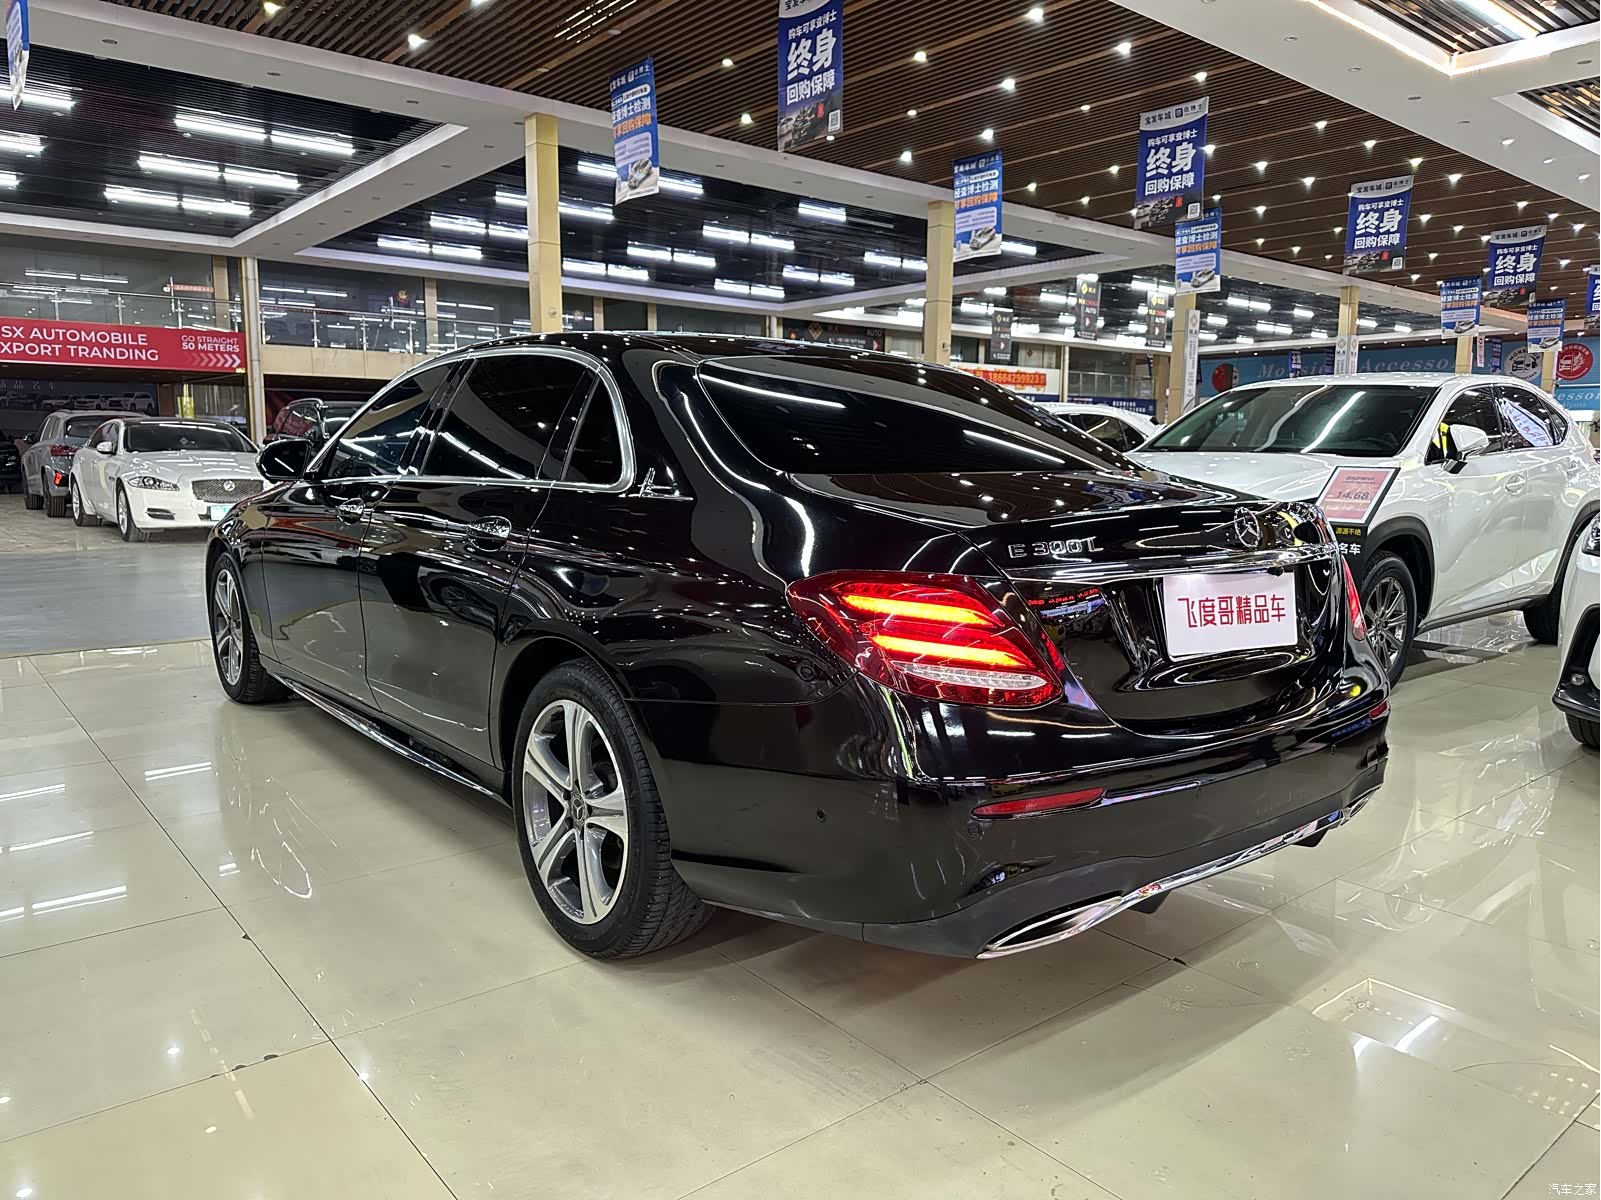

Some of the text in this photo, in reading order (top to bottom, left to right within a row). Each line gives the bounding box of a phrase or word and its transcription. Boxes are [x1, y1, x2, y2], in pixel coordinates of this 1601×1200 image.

[788, 9, 838, 41] 购车可享查博士
[787, 28, 837, 81] 终身
[786, 69, 836, 106] 回购保障
[1147, 128, 1198, 147] 购车可享查博士
[1145, 141, 1197, 178] 终身
[1144, 172, 1195, 196] 回购保障
[1358, 198, 1405, 212] 购车可享查博士
[1355, 208, 1403, 235] 终身
[1354, 233, 1401, 250] 回购保障
[1495, 252, 1537, 275] 终身
[1493, 272, 1536, 287] 回购保障
[30, 327, 148, 346] AUTOMOBILE
[181, 335, 239, 345] GO STRAIGHT
[66, 344, 160, 361] TRANDING
[182, 342, 240, 353] 50 METERS
[1336, 491, 1370, 500] 14.68
[1008, 543, 1028, 559] E
[1177, 594, 1286, 628] 飞度哥精品车
